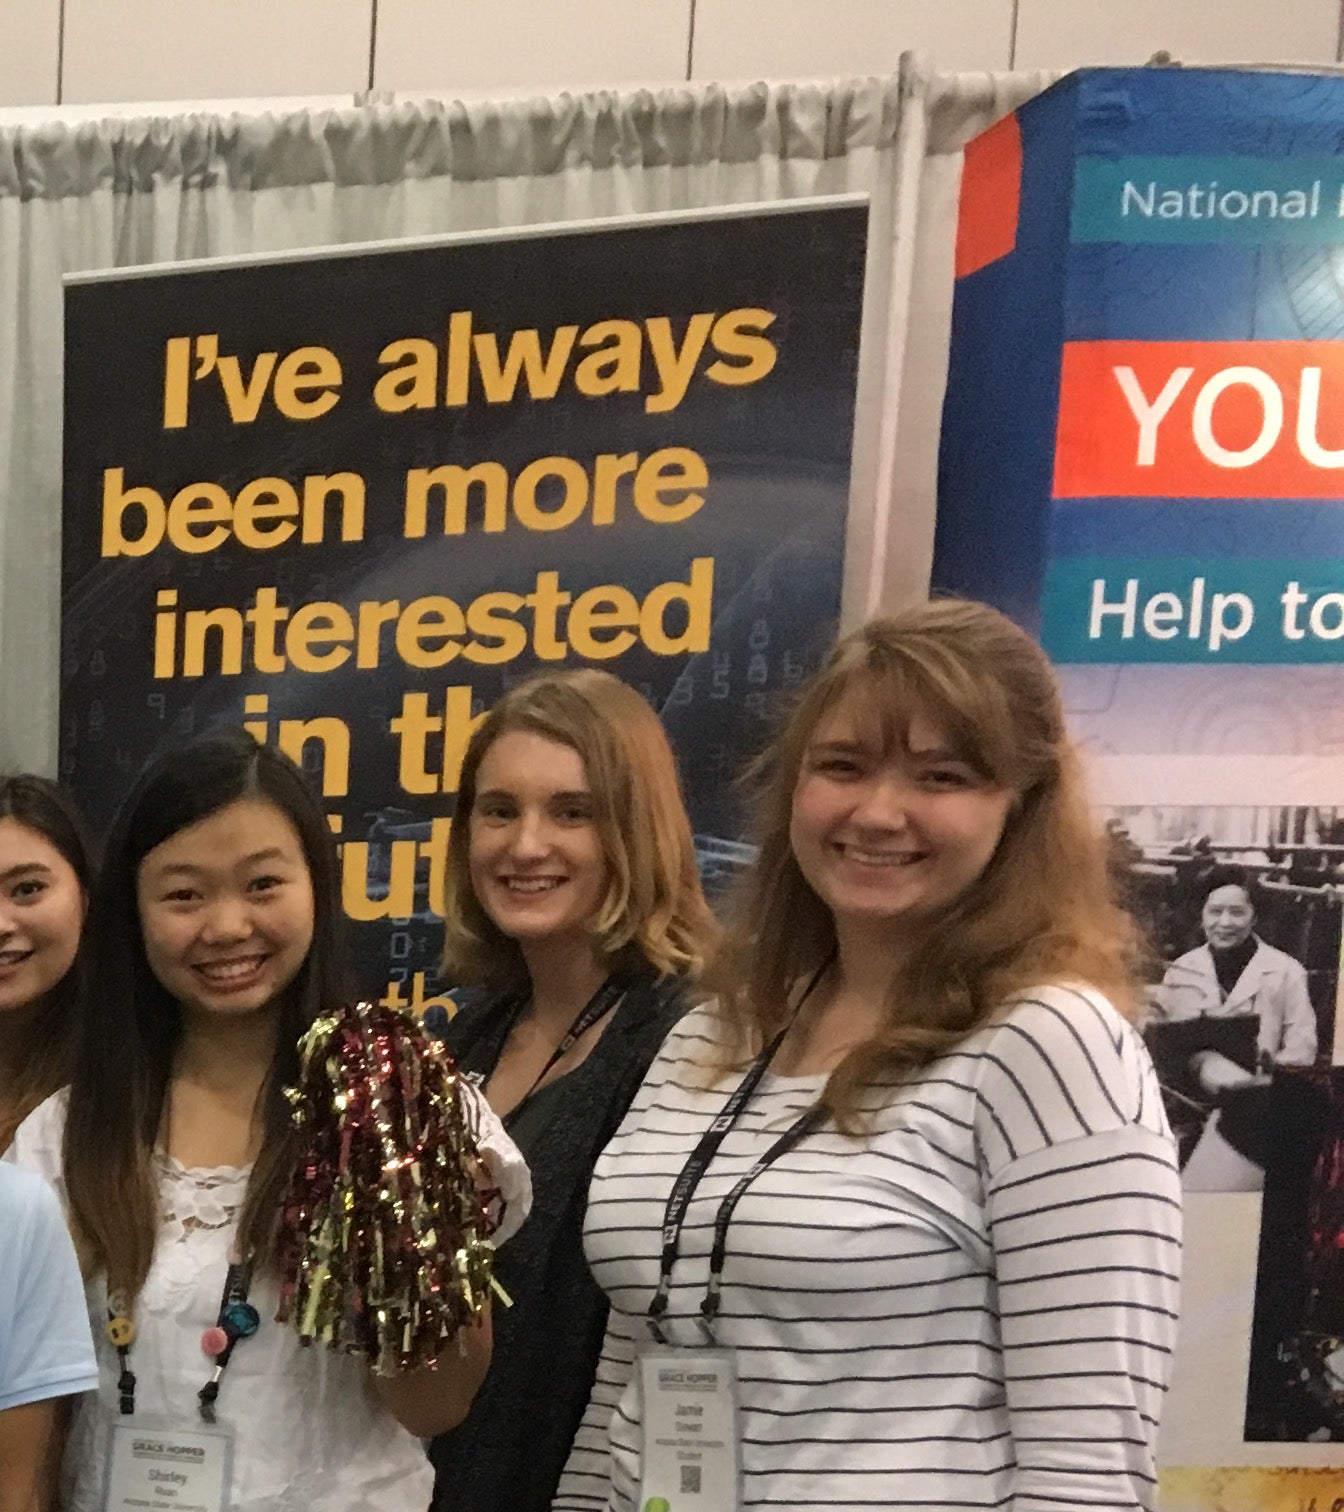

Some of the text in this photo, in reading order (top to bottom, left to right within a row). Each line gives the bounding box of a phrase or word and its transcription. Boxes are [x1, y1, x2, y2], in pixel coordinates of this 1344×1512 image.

[1121, 180, 1321, 220] National
[164, 305, 778, 430] I've always
[101, 444, 710, 559] been more
[153, 557, 714, 680] interested
[1089, 577, 1254, 651] Help
